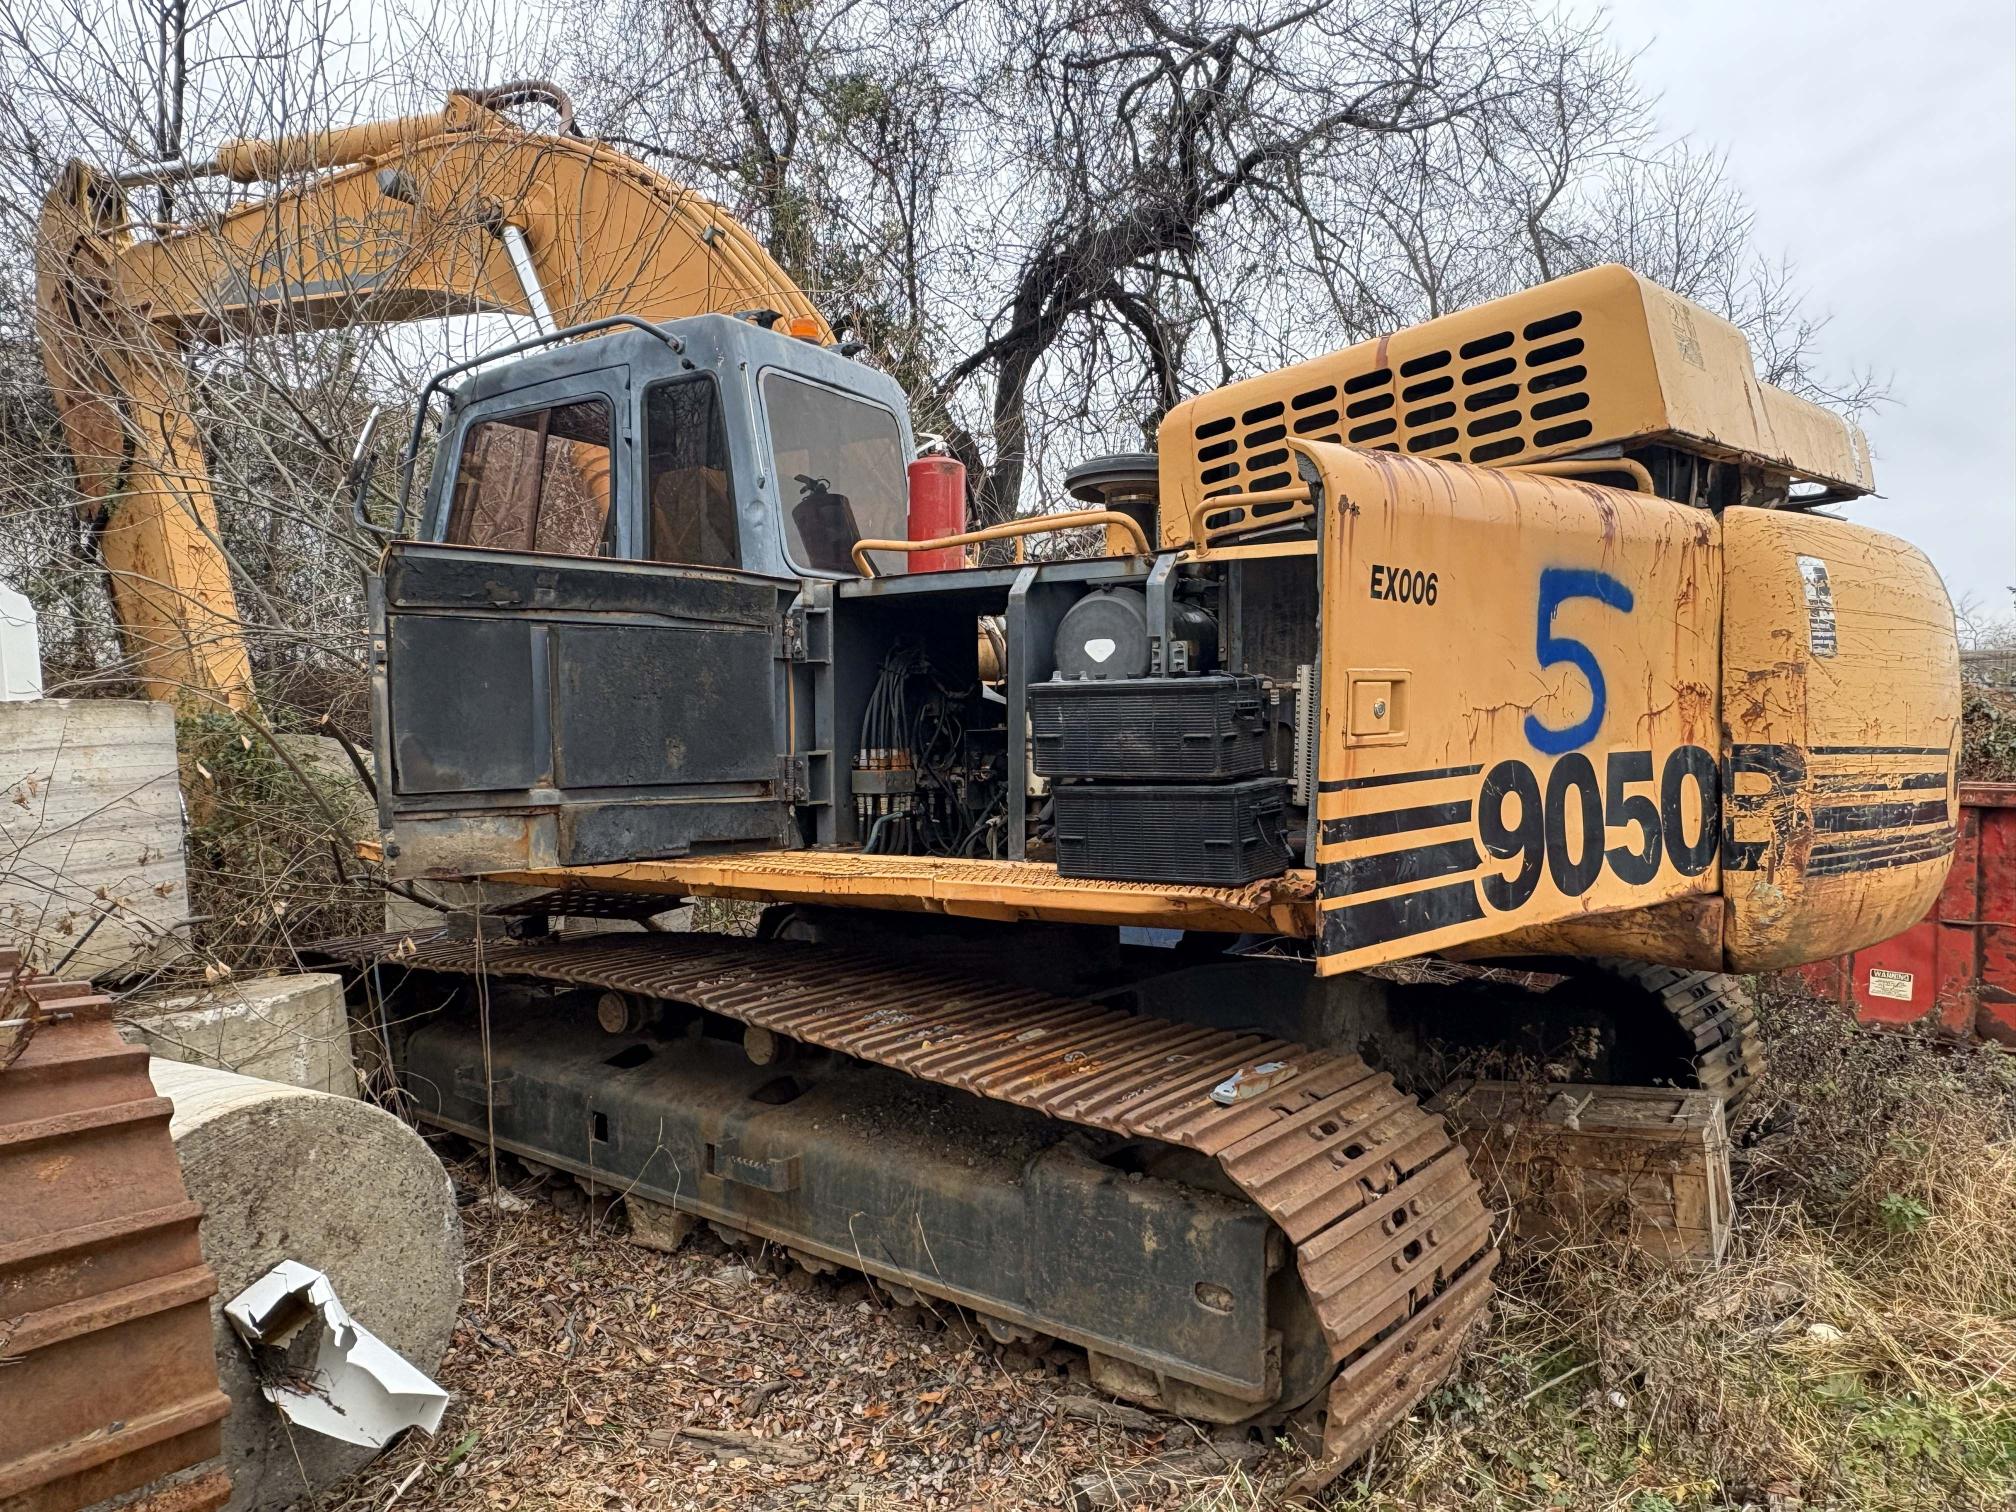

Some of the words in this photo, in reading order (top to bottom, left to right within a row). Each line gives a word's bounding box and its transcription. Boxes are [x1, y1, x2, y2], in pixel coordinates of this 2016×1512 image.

[1370, 565, 1438, 606] EX006
[1524, 567, 1633, 755] 5
[1873, 970, 1911, 982] WARNING
